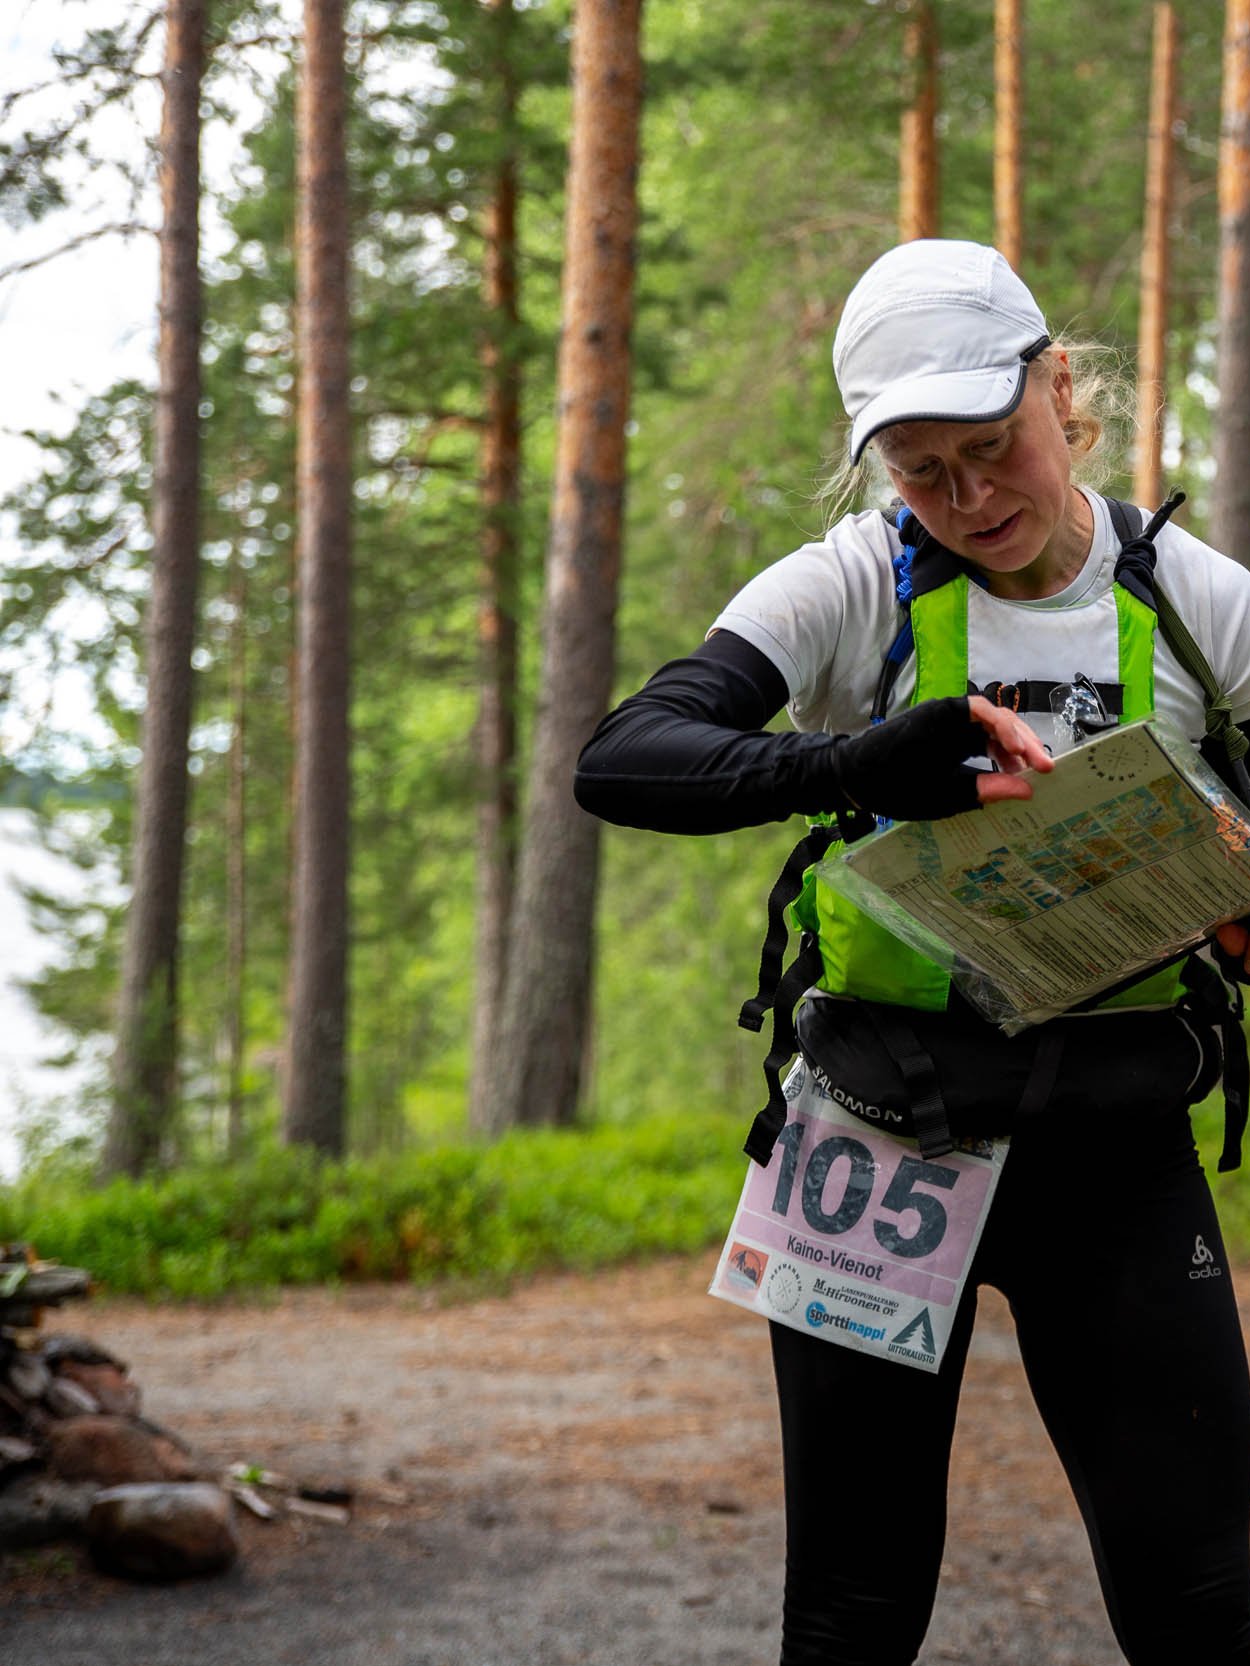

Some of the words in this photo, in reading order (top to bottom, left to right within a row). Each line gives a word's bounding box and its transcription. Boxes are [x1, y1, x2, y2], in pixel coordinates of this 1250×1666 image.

[811, 1065, 903, 1123] SALOMON
[771, 1121, 961, 1260] 105
[786, 1234, 885, 1282] Kaino-Vienot
[1188, 1265, 1222, 1280] odlo
[825, 1286, 882, 1313] Hirvonen
[809, 1308, 887, 1342] sporttinappi
